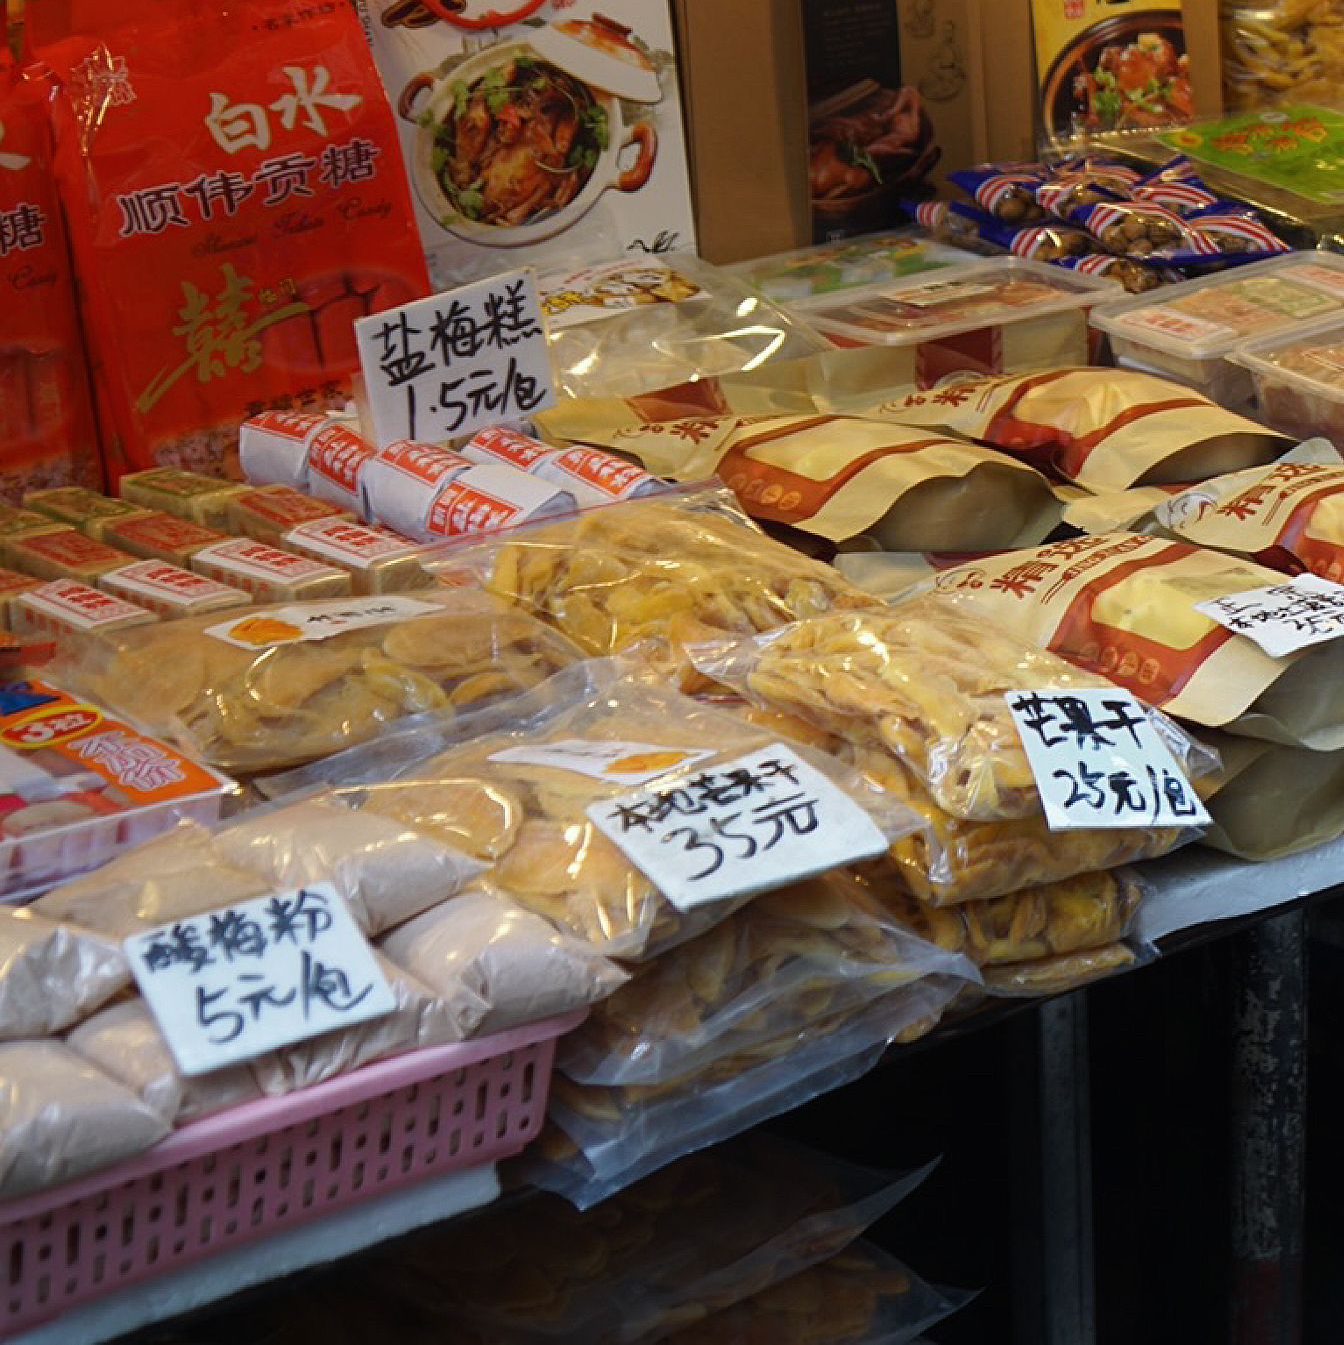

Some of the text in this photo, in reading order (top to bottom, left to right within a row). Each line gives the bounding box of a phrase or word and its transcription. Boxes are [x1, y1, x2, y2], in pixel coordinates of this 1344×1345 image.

[204, 66, 364, 155] 白水
[117, 138, 382, 239] 顺伟贡糖
[372, 278, 545, 388] 盐梅糕
[404, 358, 548, 442] 1.5元/包
[1011, 694, 1149, 751] 芒果干
[605, 757, 801, 838] 本地芒果干
[664, 792, 821, 883] 35元
[1052, 763, 1199, 827] 25元/包
[138, 891, 335, 976] 酸梅粉
[195, 952, 375, 1046] 5元/包
